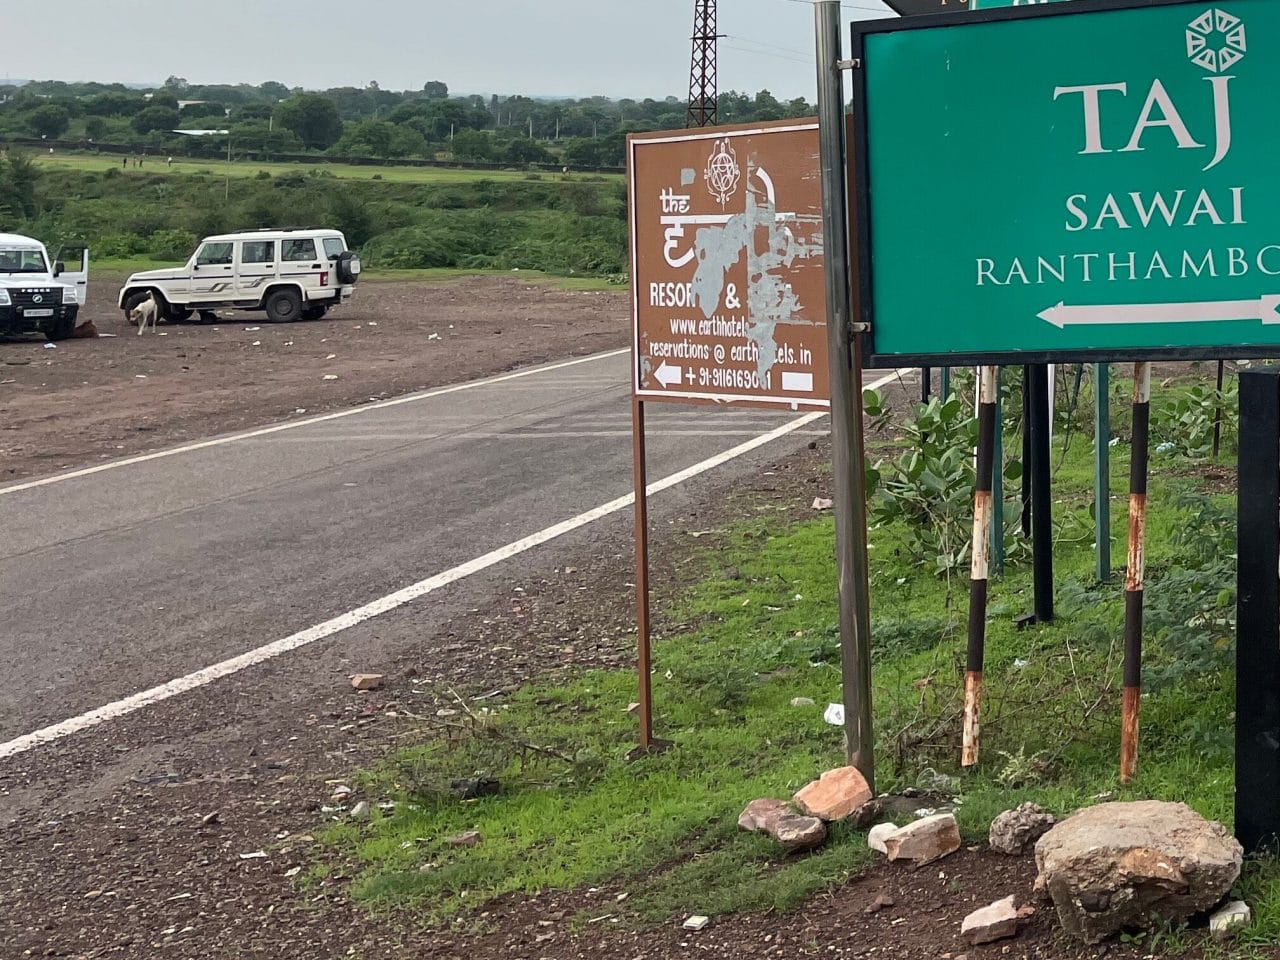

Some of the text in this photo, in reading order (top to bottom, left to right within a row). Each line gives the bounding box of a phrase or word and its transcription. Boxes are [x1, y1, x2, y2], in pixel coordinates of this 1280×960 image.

[1053, 76, 1237, 171] TAJ
[659, 186, 690, 213] the
[1066, 187, 1248, 232] SAWAI
[725, 282, 742, 309] &
[650, 338, 709, 359] reservations
[714, 344, 725, 364] @
